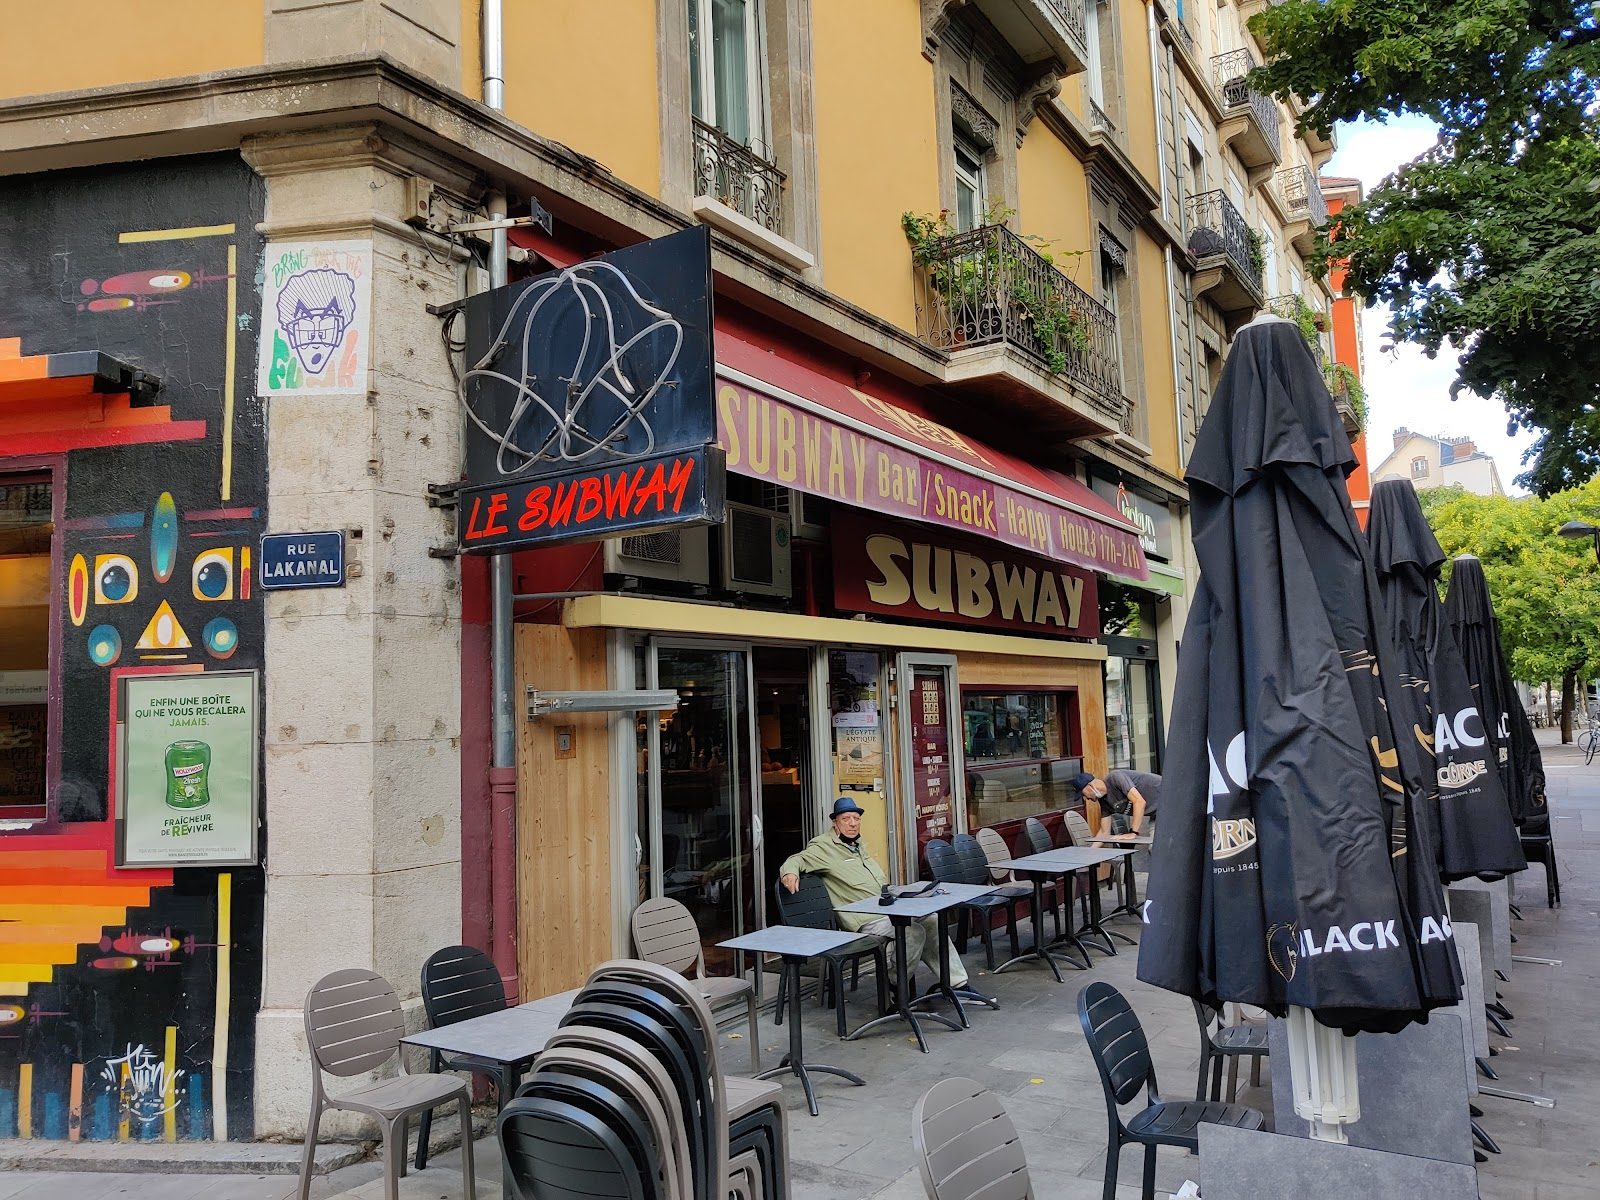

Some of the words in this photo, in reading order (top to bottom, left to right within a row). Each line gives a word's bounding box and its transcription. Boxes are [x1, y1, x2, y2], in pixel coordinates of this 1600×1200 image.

[717, 385, 865, 504] SUBWAY
[465, 493, 508, 540] LE
[518, 457, 695, 532] SUBWAY
[287, 543, 316, 555] RUE
[264, 560, 338, 578] LAKANAL
[865, 534, 1084, 629] SUBWAY
[150, 698, 177, 707] ENFIN
[179, 696, 199, 706] UNE
[202, 694, 231, 705] BOÎTE
[135, 709, 151, 718] QUI
[153, 708, 165, 717] NE
[168, 707, 193, 717] VOUS
[196, 706, 246, 716] RECALERA
[169, 717, 210, 727] JAMAIS.
[846, 735, 877, 743] ANTIQUE
[164, 813, 212, 827] FRAÎCHEUR
[171, 823, 214, 837] REVIVRE
[1237, 862, 1259, 872] 1845
